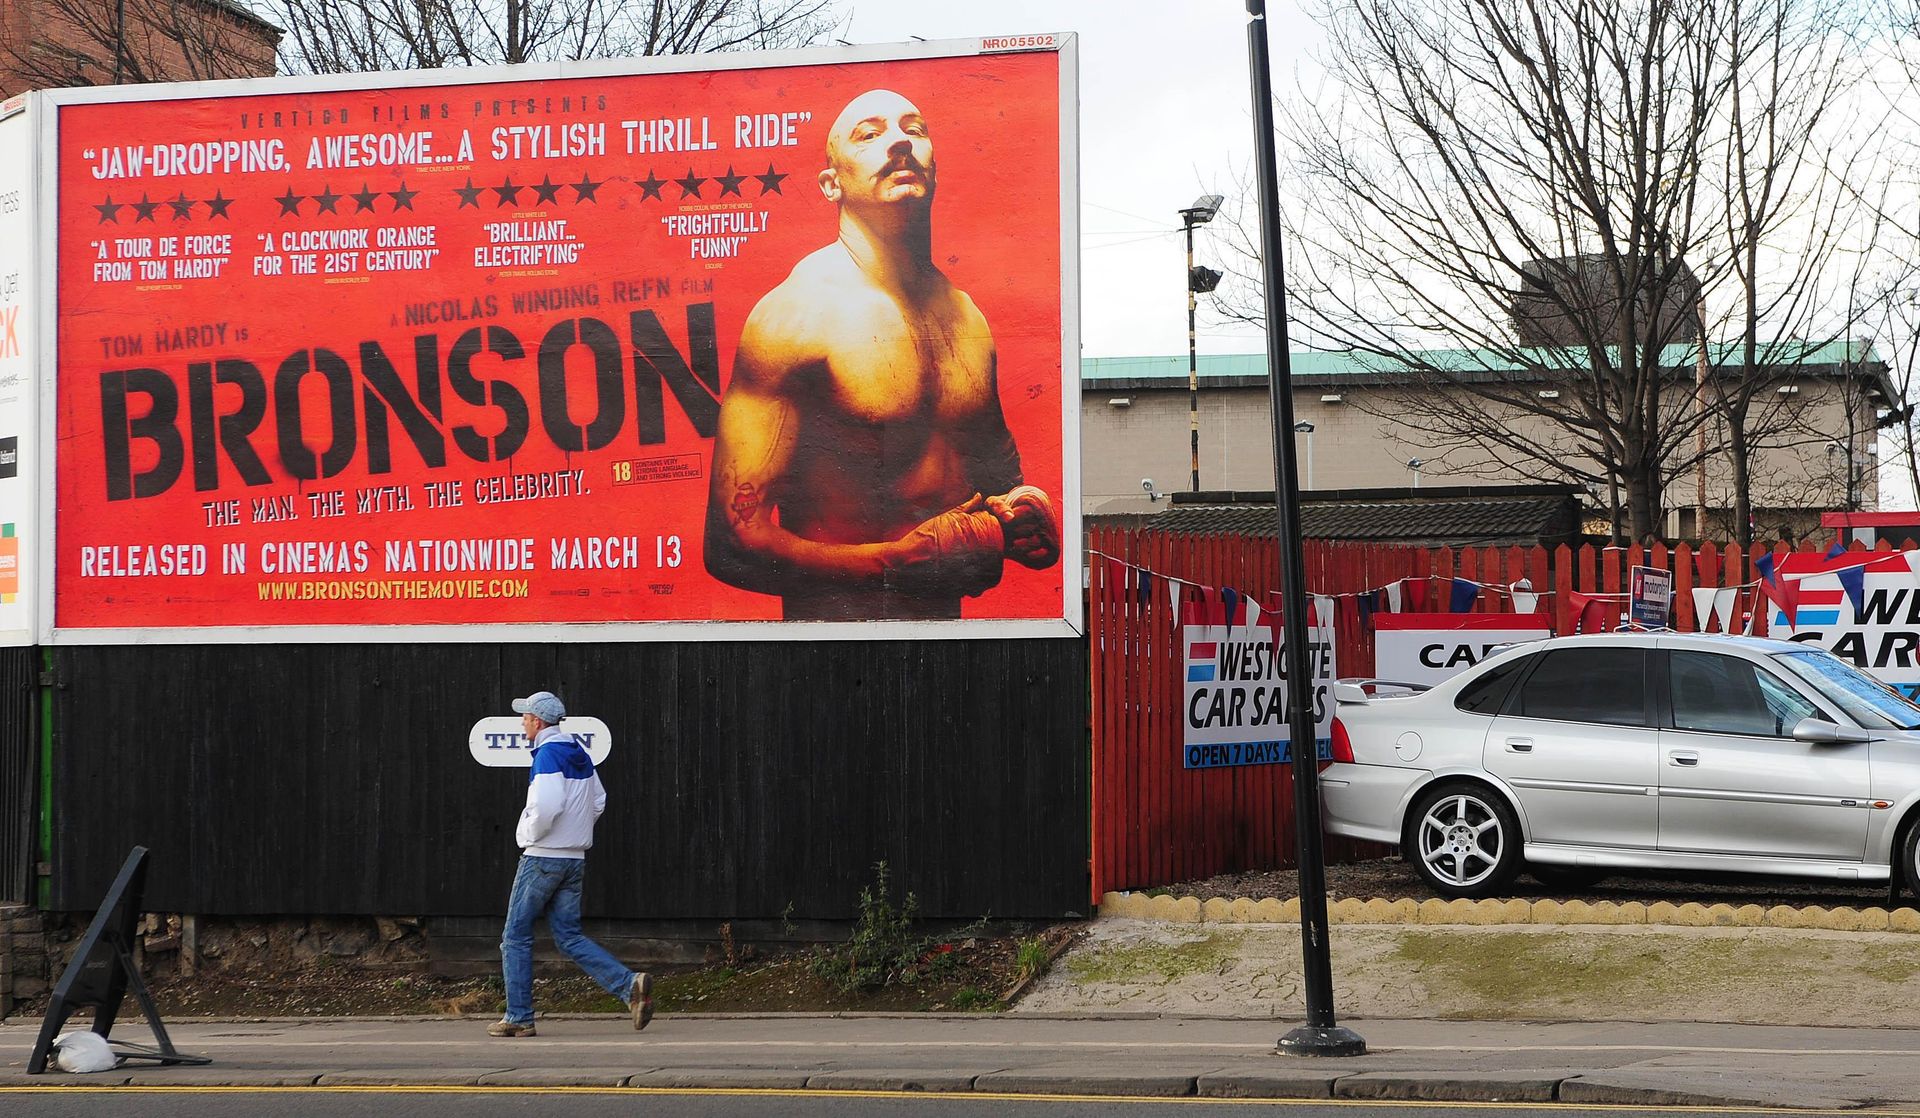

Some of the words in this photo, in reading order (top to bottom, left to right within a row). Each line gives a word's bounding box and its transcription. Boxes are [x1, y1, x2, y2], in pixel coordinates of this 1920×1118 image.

[983, 35, 1053, 49] NR005502
[241, 108, 348, 129] VERTIGO
[373, 103, 449, 123] FILMS
[474, 95, 606, 117] PRESENTS
[83, 138, 291, 179] “JAW-DROPPING,
[491, 122, 605, 161] STYLISH
[622, 117, 717, 154] THRILL
[735, 112, 811, 148] RIDE”
[483, 219, 576, 243] “BRILLIANT...
[661, 211, 768, 237] “FRIGHTFULLY
[90, 239, 107, 260] “A
[115, 238, 152, 258] TOUR
[159, 237, 178, 257] DE
[184, 234, 232, 256] FORCE
[257, 231, 274, 252] “A
[282, 228, 368, 251] CLOCKWORK
[376, 226, 436, 248] ORANGE
[690, 236, 747, 259] FUNNY”
[253, 255, 282, 276] FOR
[290, 254, 316, 275] THE
[325, 252, 358, 273] 21ST
[365, 249, 440, 271] CENTURY”
[474, 243, 585, 267] ELECTRIFYING”
[94, 262, 131, 282] FROM
[139, 260, 167, 280] TOM
[174, 258, 228, 279] HARDY”
[404, 293, 498, 327] NICOLAS
[512, 282, 600, 313] WINDING
[613, 277, 670, 302] REFN
[681, 277, 713, 296] FILM
[101, 334, 143, 360] TOM
[155, 321, 229, 351] HARDY
[235, 327, 249, 342] IS
[100, 301, 721, 501] BRONSON
[612, 461, 631, 482] 18
[672, 469, 699, 478] VIOLENCE
[203, 499, 240, 528] THE
[252, 494, 298, 524] MAN.
[307, 490, 345, 519] THE
[356, 485, 414, 515] MYTH.
[424, 481, 462, 508] THE
[474, 469, 591, 505] CELEBRITY.
[81, 544, 207, 577] RELEASED
[222, 543, 246, 575] IN
[261, 540, 369, 574] CINEMAS
[385, 536, 534, 573] NATIONWIDE
[550, 536, 638, 571] MARCH
[656, 535, 682, 569] 13
[258, 579, 528, 601] WWW.BRONSONTHEMOVIE.COM
[1220, 642, 1332, 681] WESTGTE
[1787, 632, 1920, 668] AR
[1189, 687, 1246, 729] CAR
[1251, 685, 1327, 726] SAS
[485, 733, 595, 749] TITN
[1189, 744, 1230, 767] OPEN
[1234, 744, 1242, 765] 7
[1245, 742, 1280, 763] DAYS
